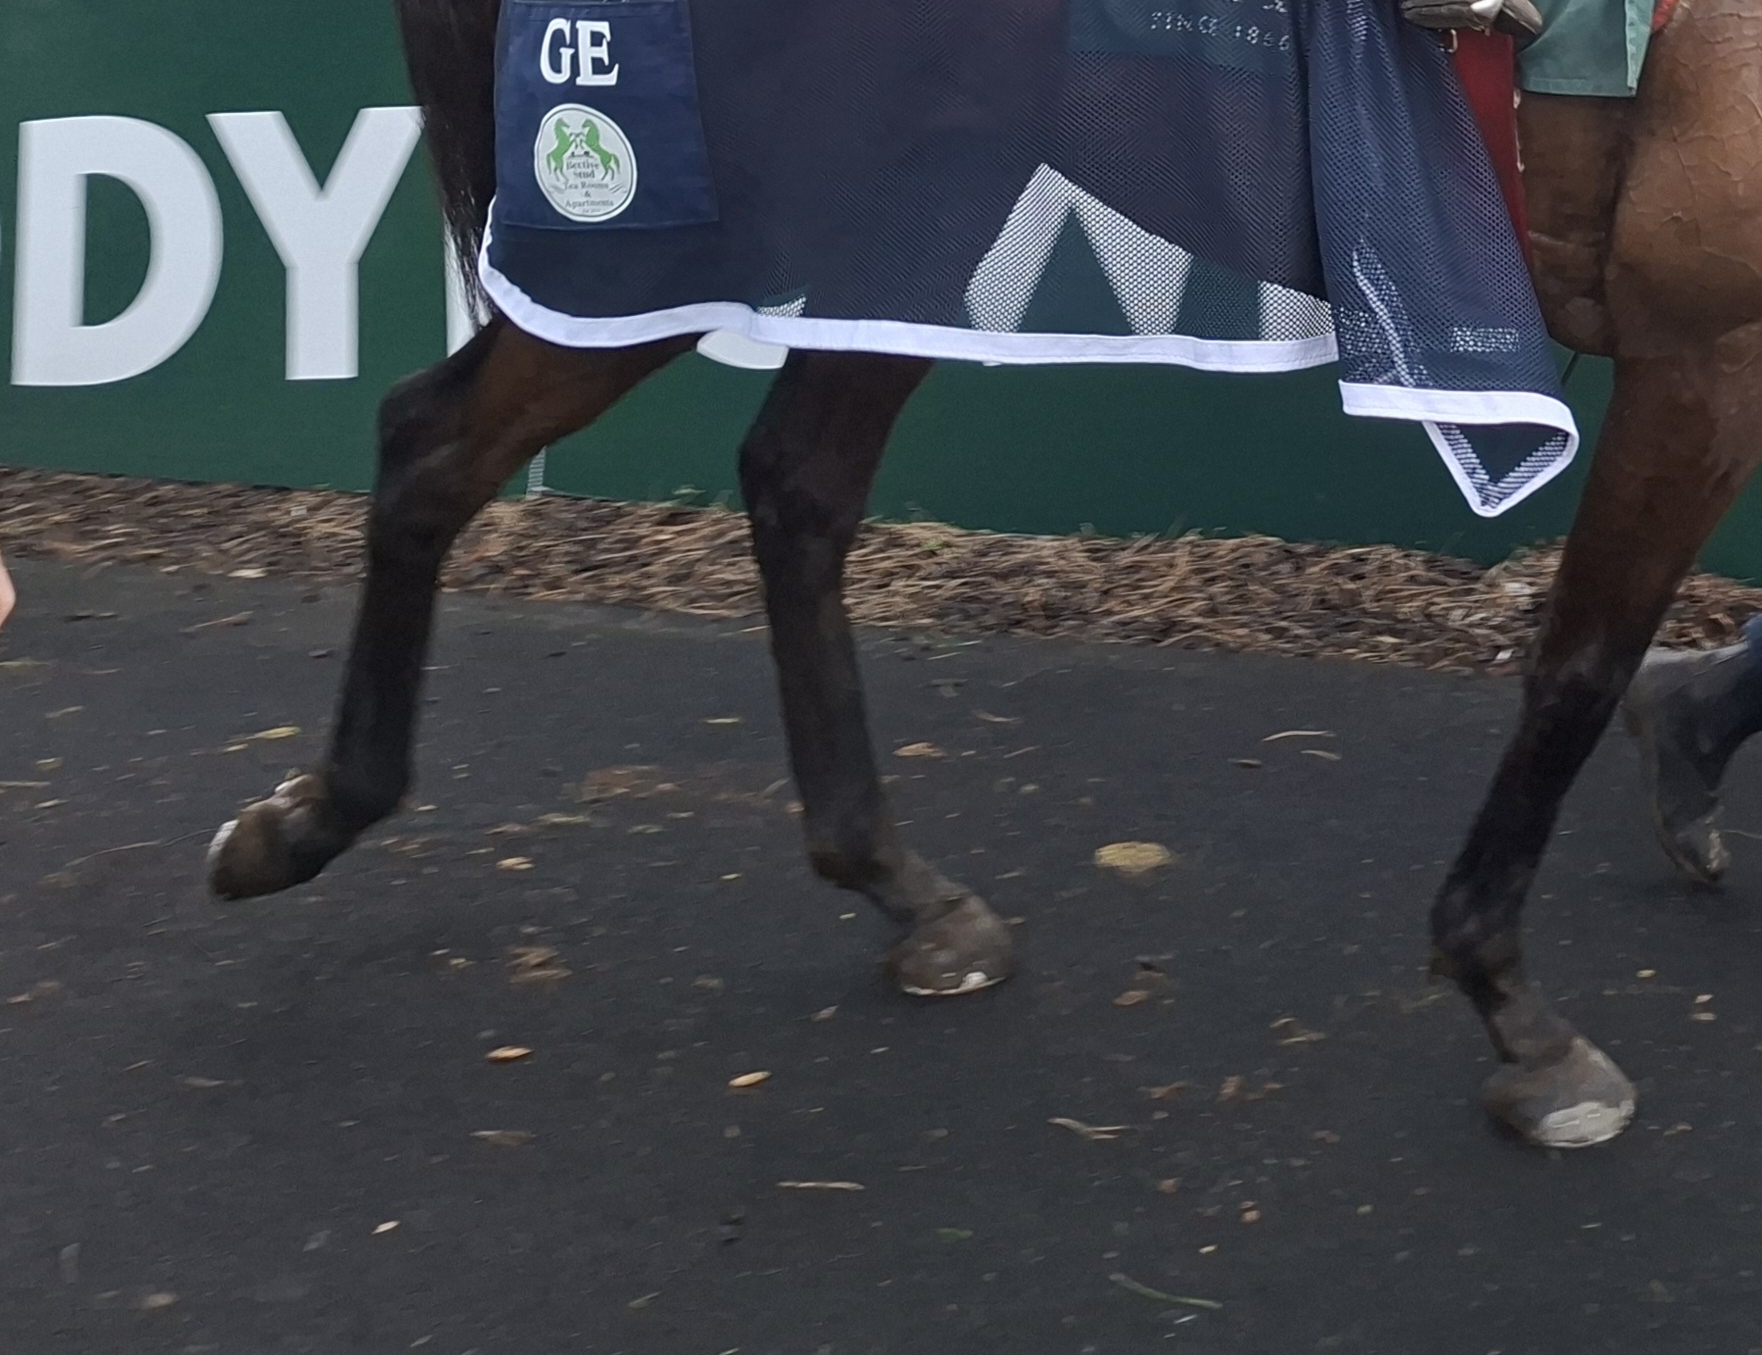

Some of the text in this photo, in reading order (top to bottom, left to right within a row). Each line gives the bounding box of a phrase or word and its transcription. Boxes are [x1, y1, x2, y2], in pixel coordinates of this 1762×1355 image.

[540, 18, 620, 86] GE
[572, 169, 596, 179] Stud
[564, 199, 615, 210] Apartments
